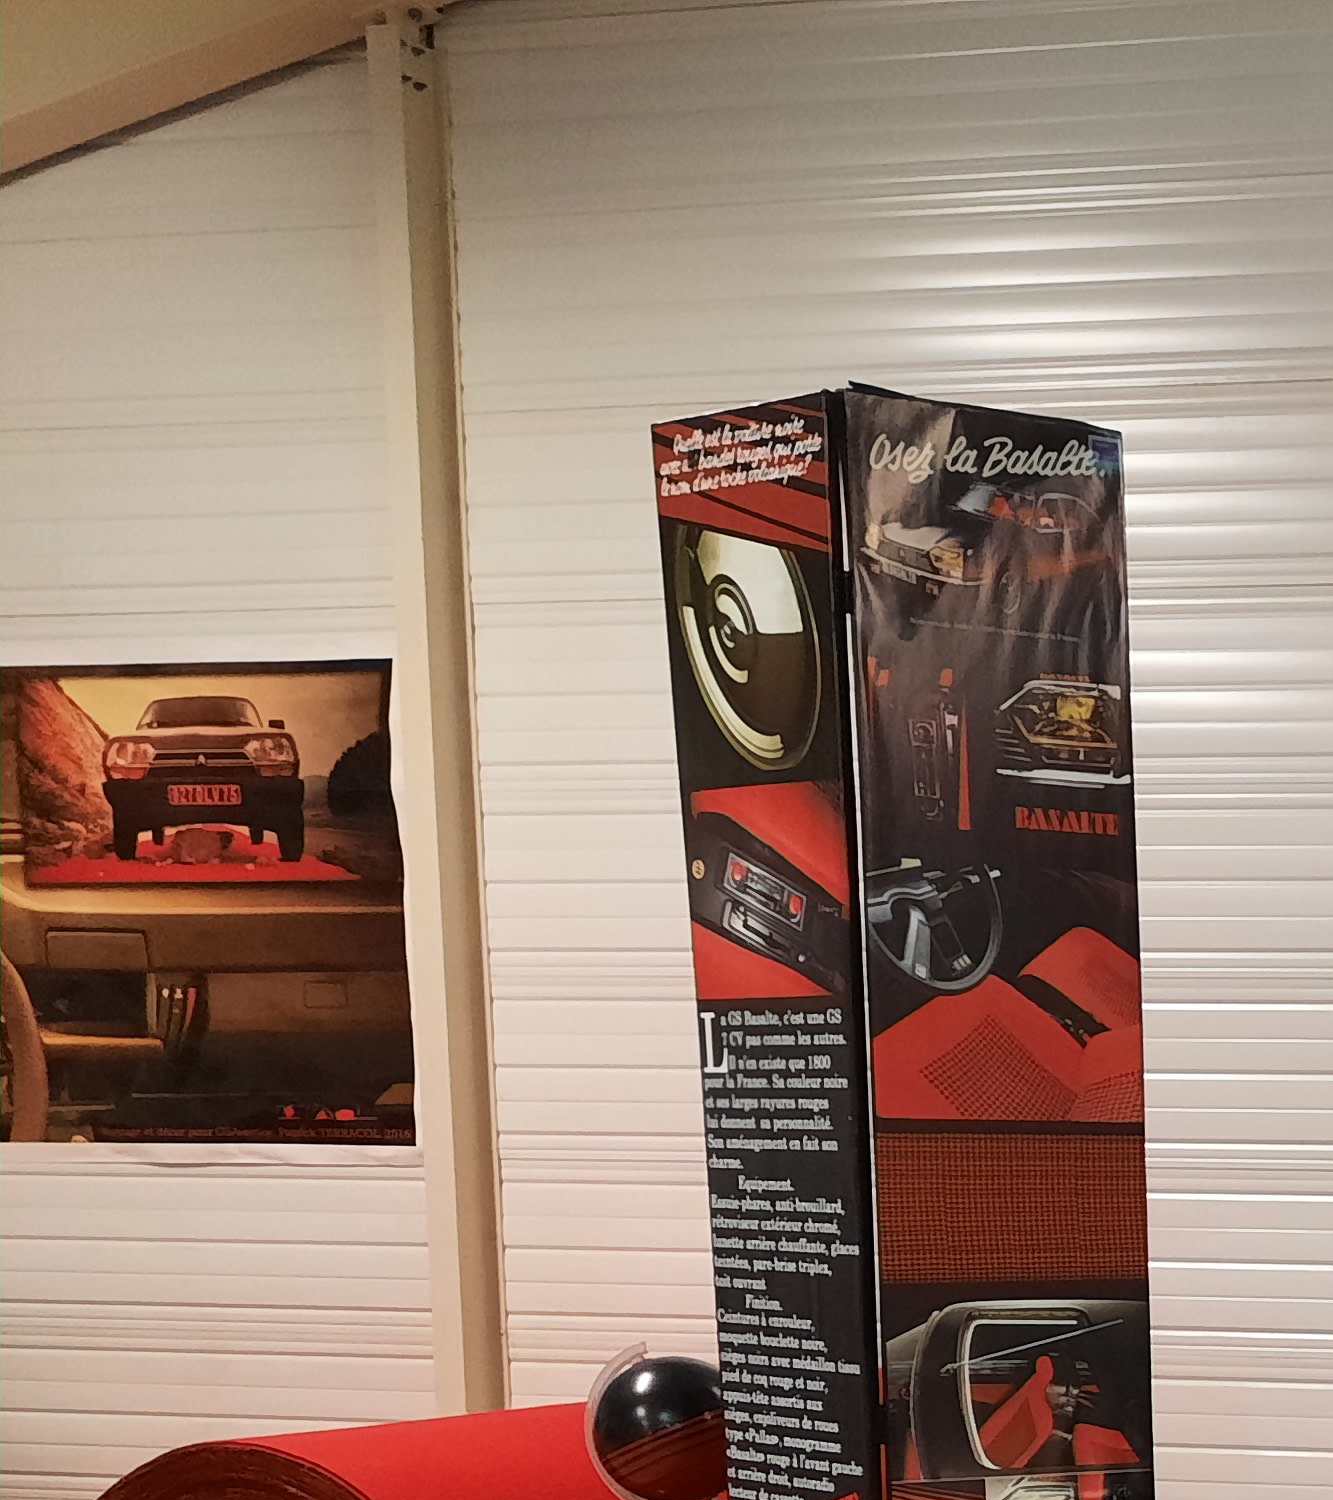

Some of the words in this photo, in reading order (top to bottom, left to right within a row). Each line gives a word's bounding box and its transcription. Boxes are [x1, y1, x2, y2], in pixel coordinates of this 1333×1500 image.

[869, 433, 934, 484] Osez
[944, 436, 978, 474] la
[1015, 805, 1119, 836] BASALTE
